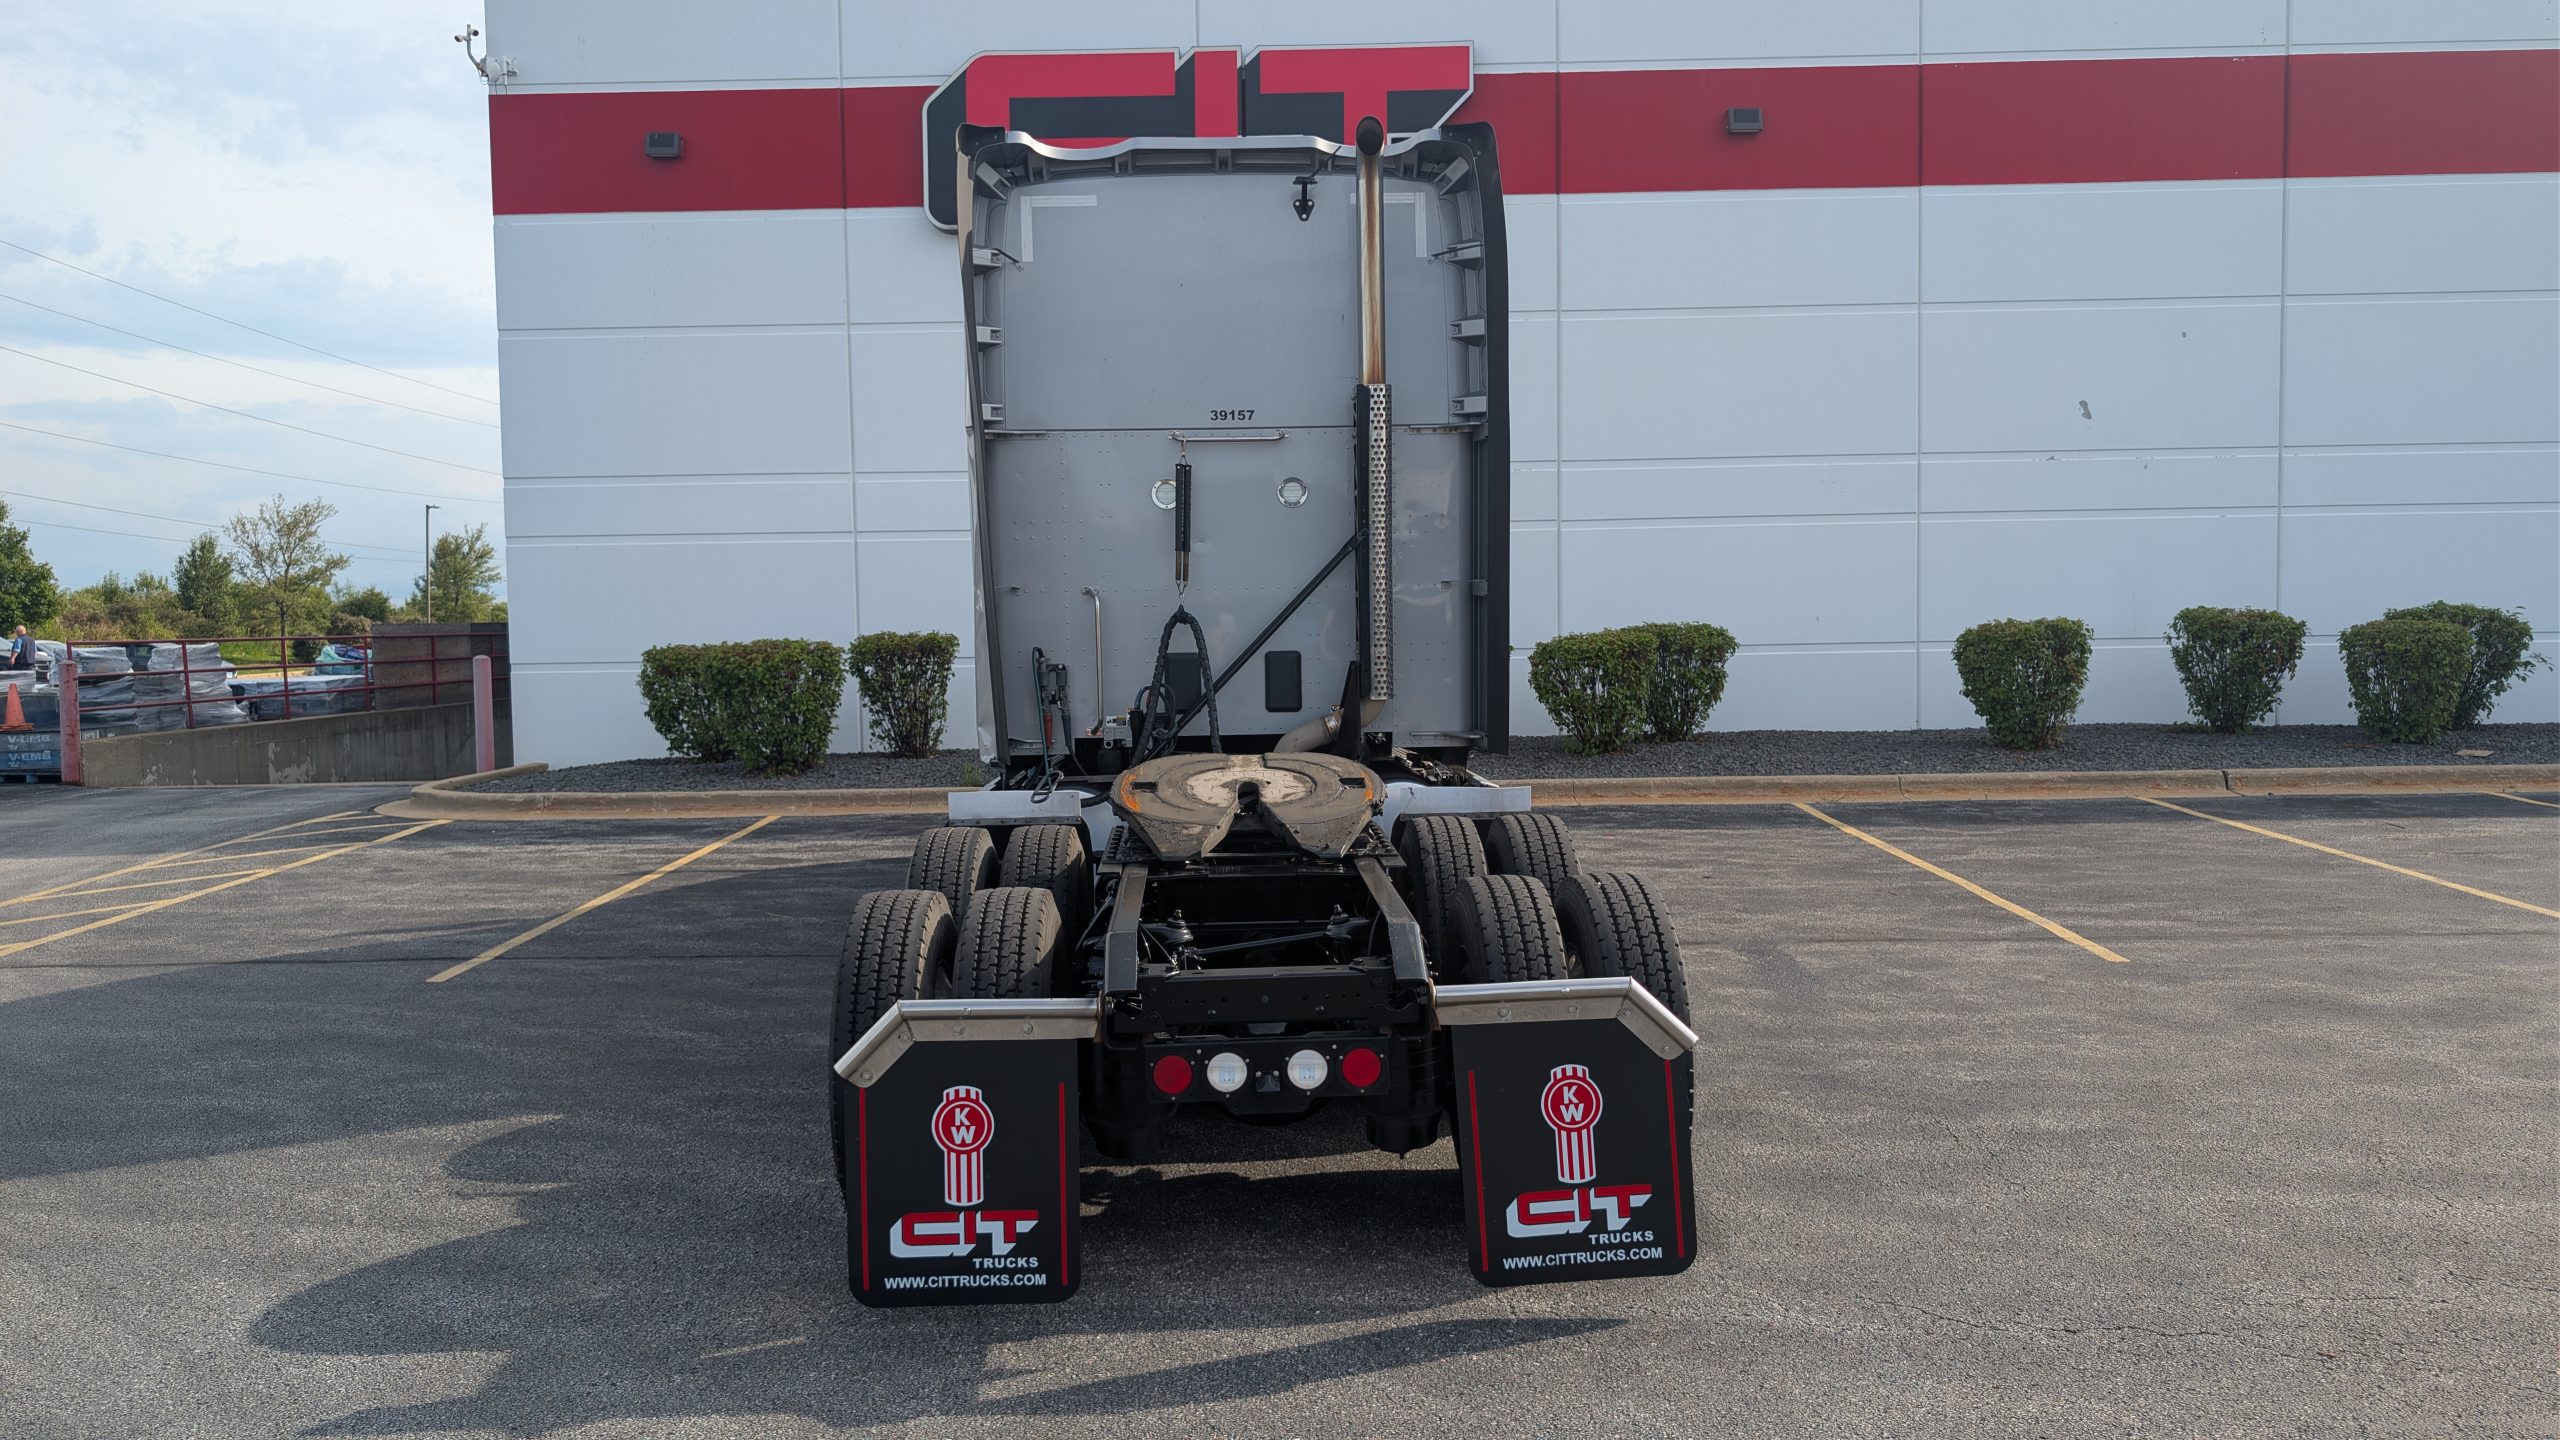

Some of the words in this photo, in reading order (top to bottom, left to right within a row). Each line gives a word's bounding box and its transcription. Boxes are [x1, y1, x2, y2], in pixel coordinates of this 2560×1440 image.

[1210, 409, 1255, 421] 39157
[1506, 1184, 1652, 1238] CIT
[890, 1210, 1039, 1258] CIT
[1588, 1230, 1654, 1245] TRUCKS
[972, 1257, 1039, 1269] TRUCKS
[1503, 1247, 1663, 1270] WWW.CITTRUCKS.COM
[884, 1274, 1047, 1290] WWW.CITTRUCKS.COM
